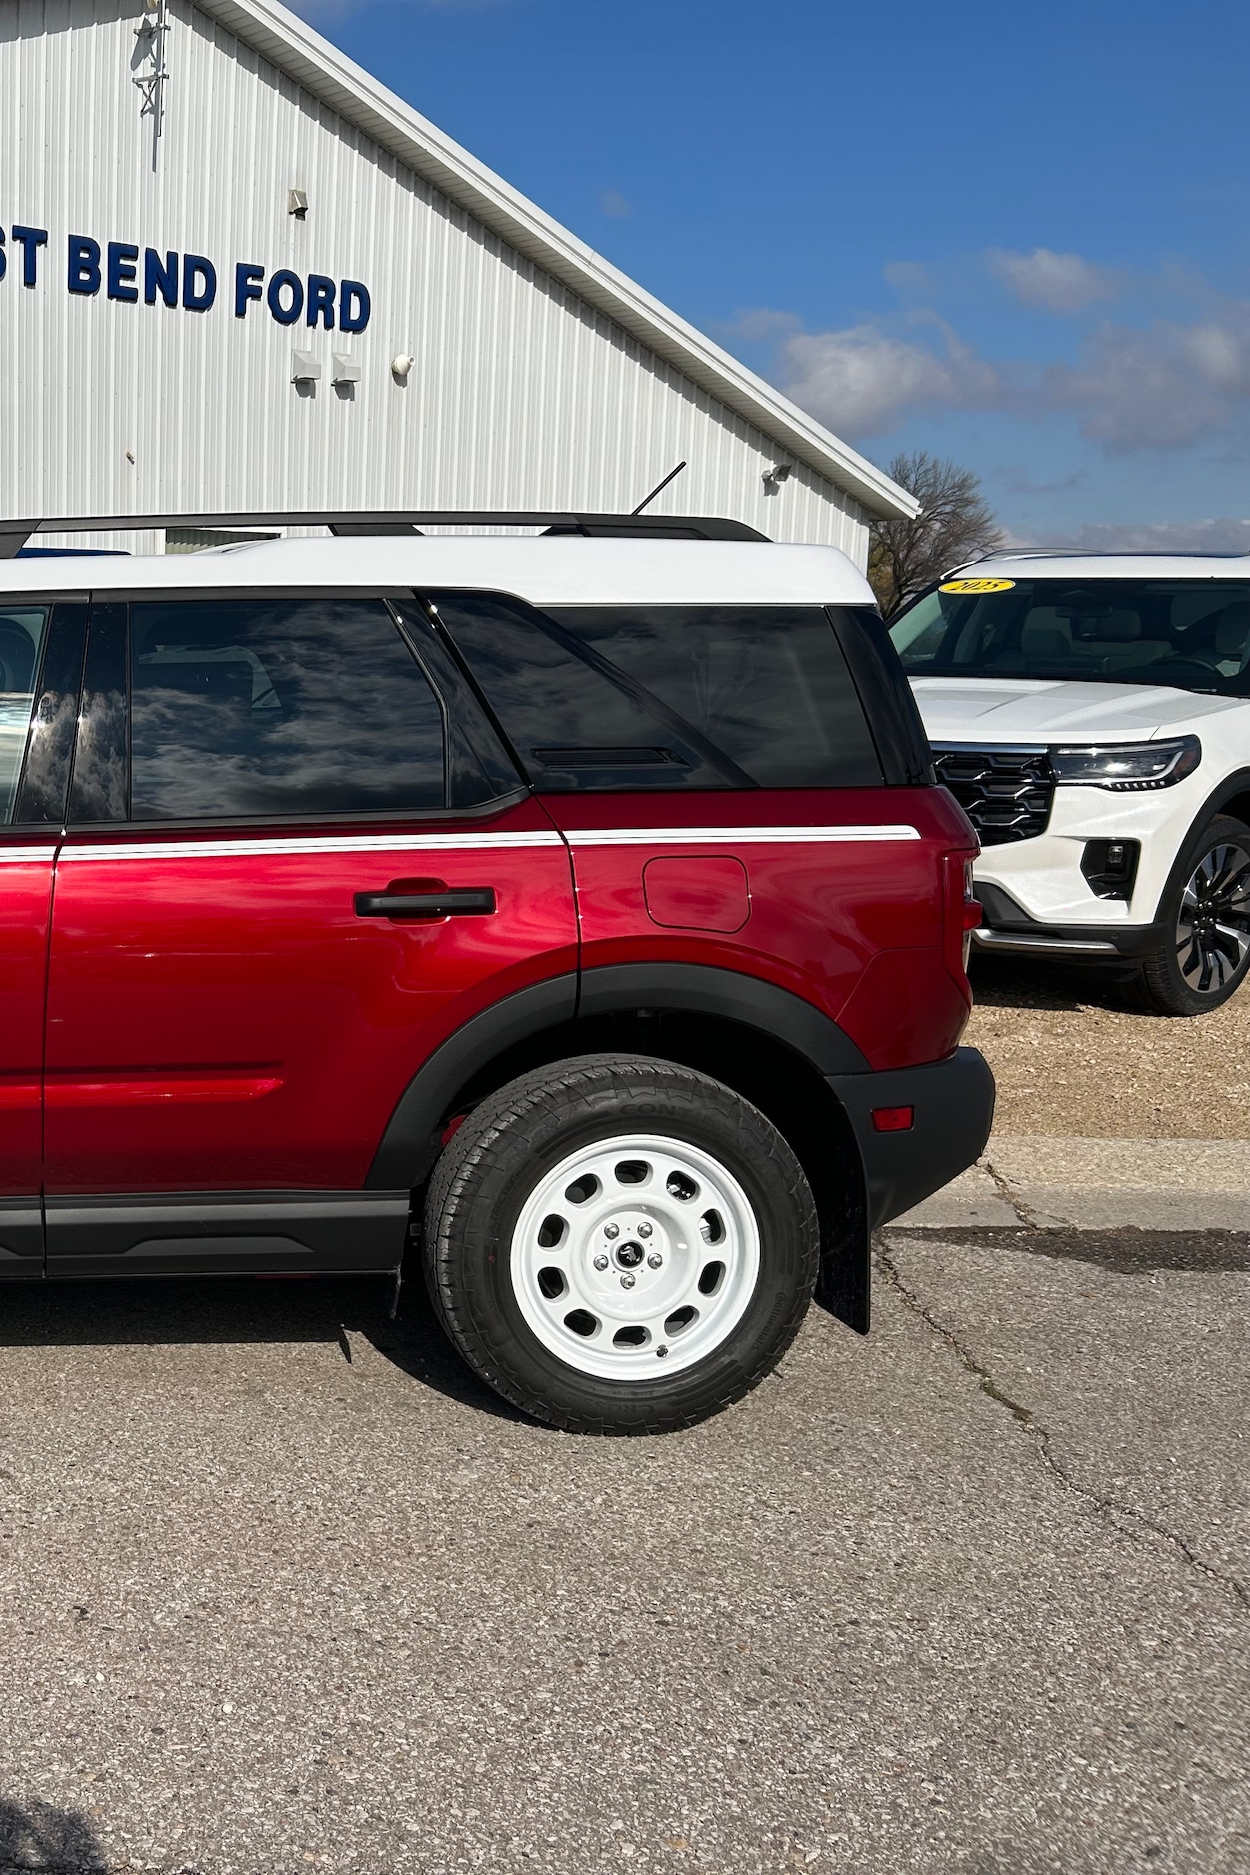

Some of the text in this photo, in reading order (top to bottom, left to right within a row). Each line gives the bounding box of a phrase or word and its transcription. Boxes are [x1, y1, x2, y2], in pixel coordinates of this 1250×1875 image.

[67, 234, 217, 312] BEND
[234, 262, 371, 334] FORD
[947, 581, 1007, 592] 2025
[755, 1291, 788, 1345] Continental
